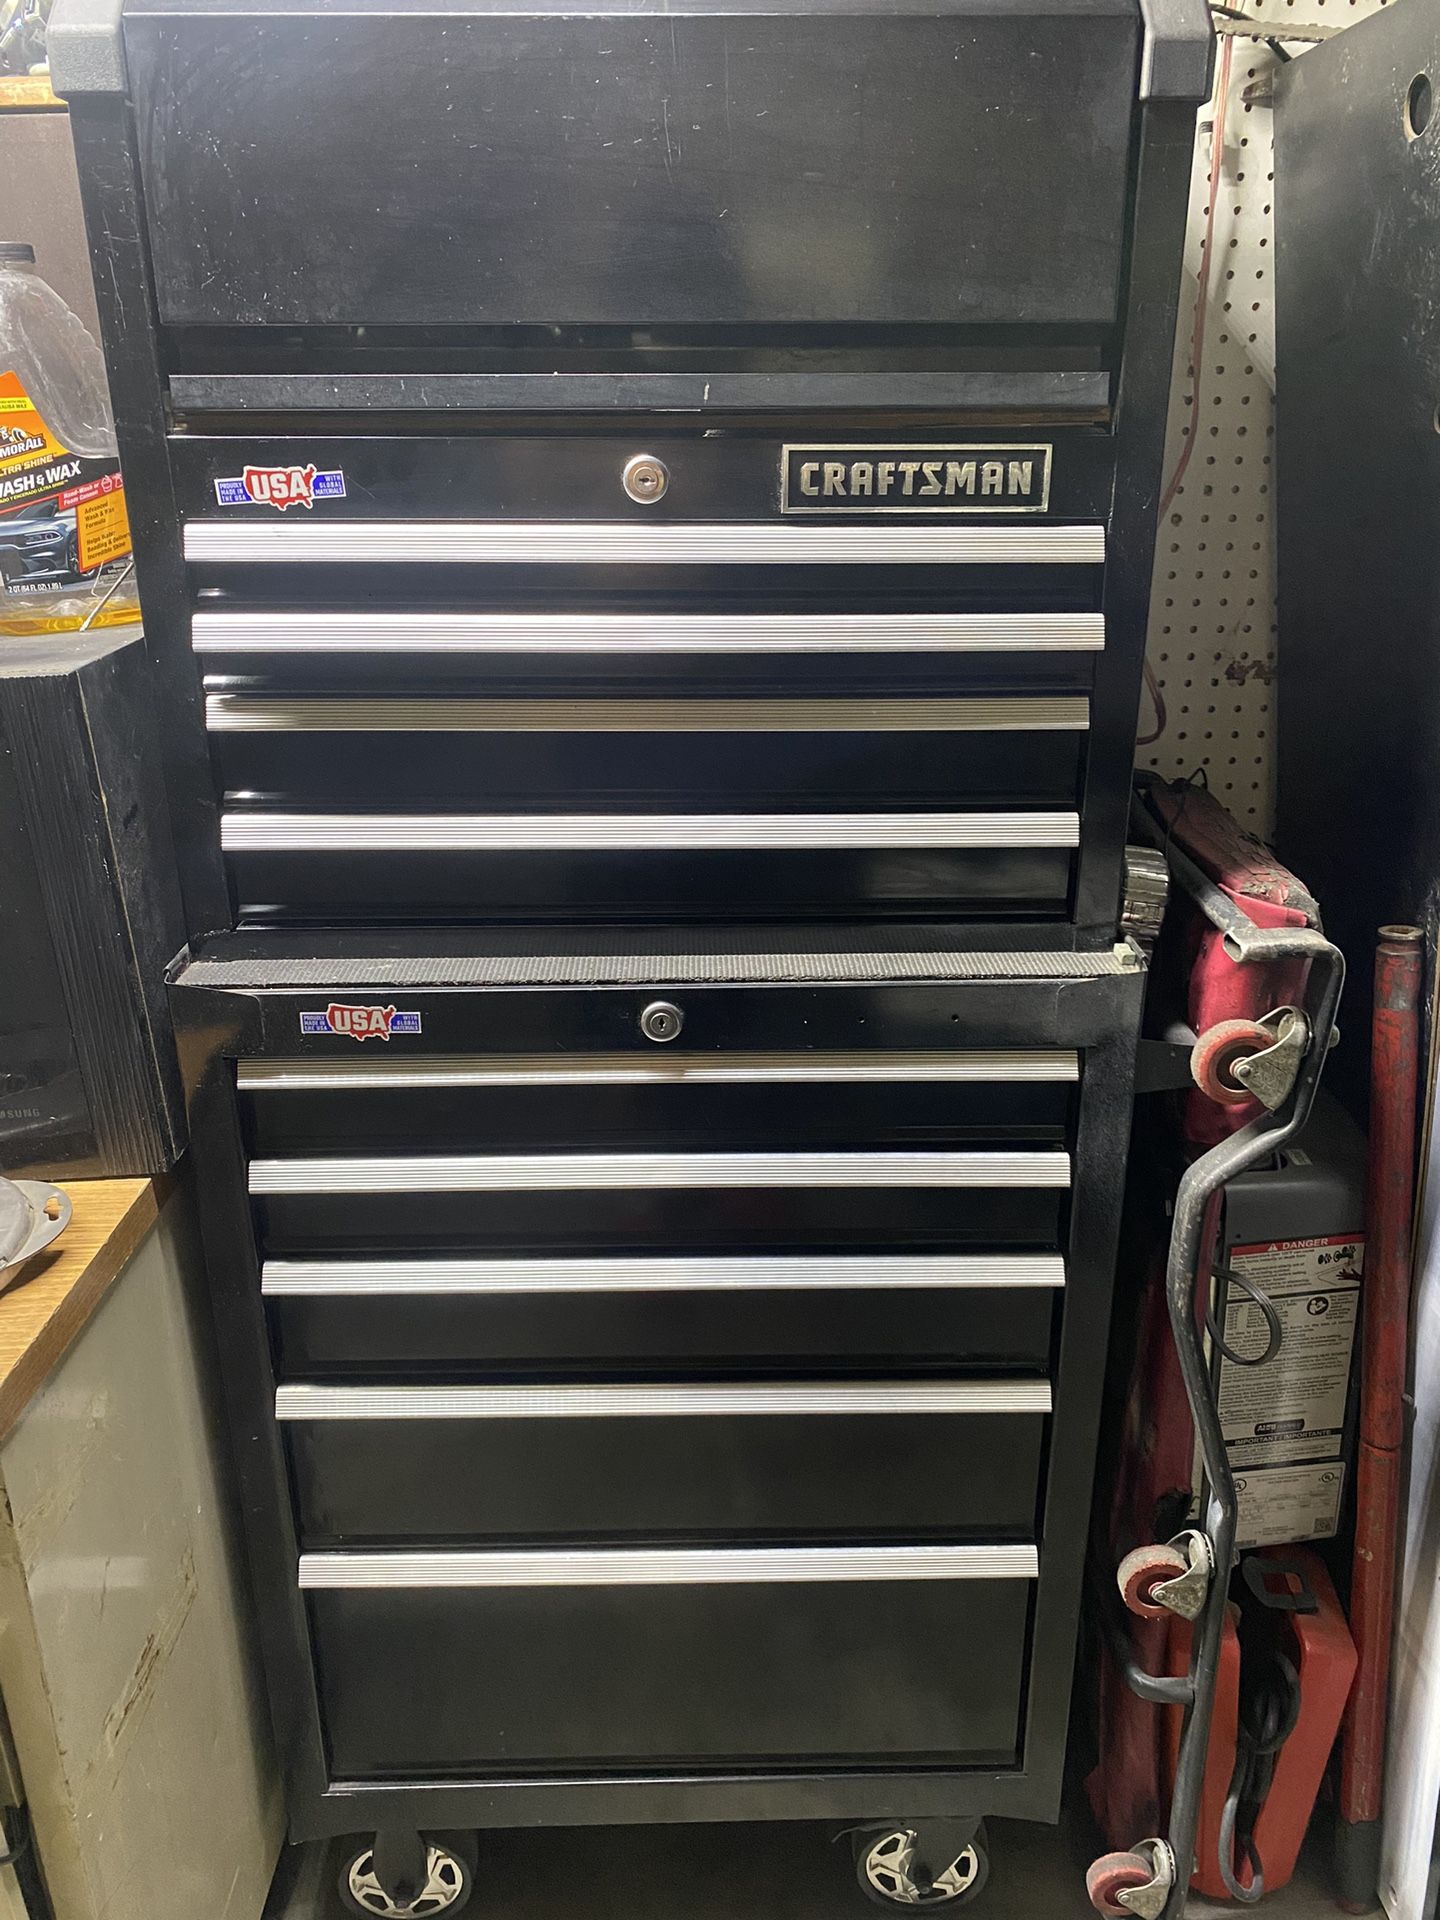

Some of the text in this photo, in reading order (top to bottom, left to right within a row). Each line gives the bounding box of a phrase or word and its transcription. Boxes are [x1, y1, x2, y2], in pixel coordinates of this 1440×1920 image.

[0, 460, 82, 498] ASH & WAX
[251, 471, 310, 500] USA
[800, 461, 1033, 496] CRAFTSMAN
[334, 1010, 388, 1031] USA
[1282, 1238, 1328, 1250] DANGER
[1234, 1436, 1278, 1445] IMPORTANT
[1283, 1430, 1332, 1440] IMPORTANTE
